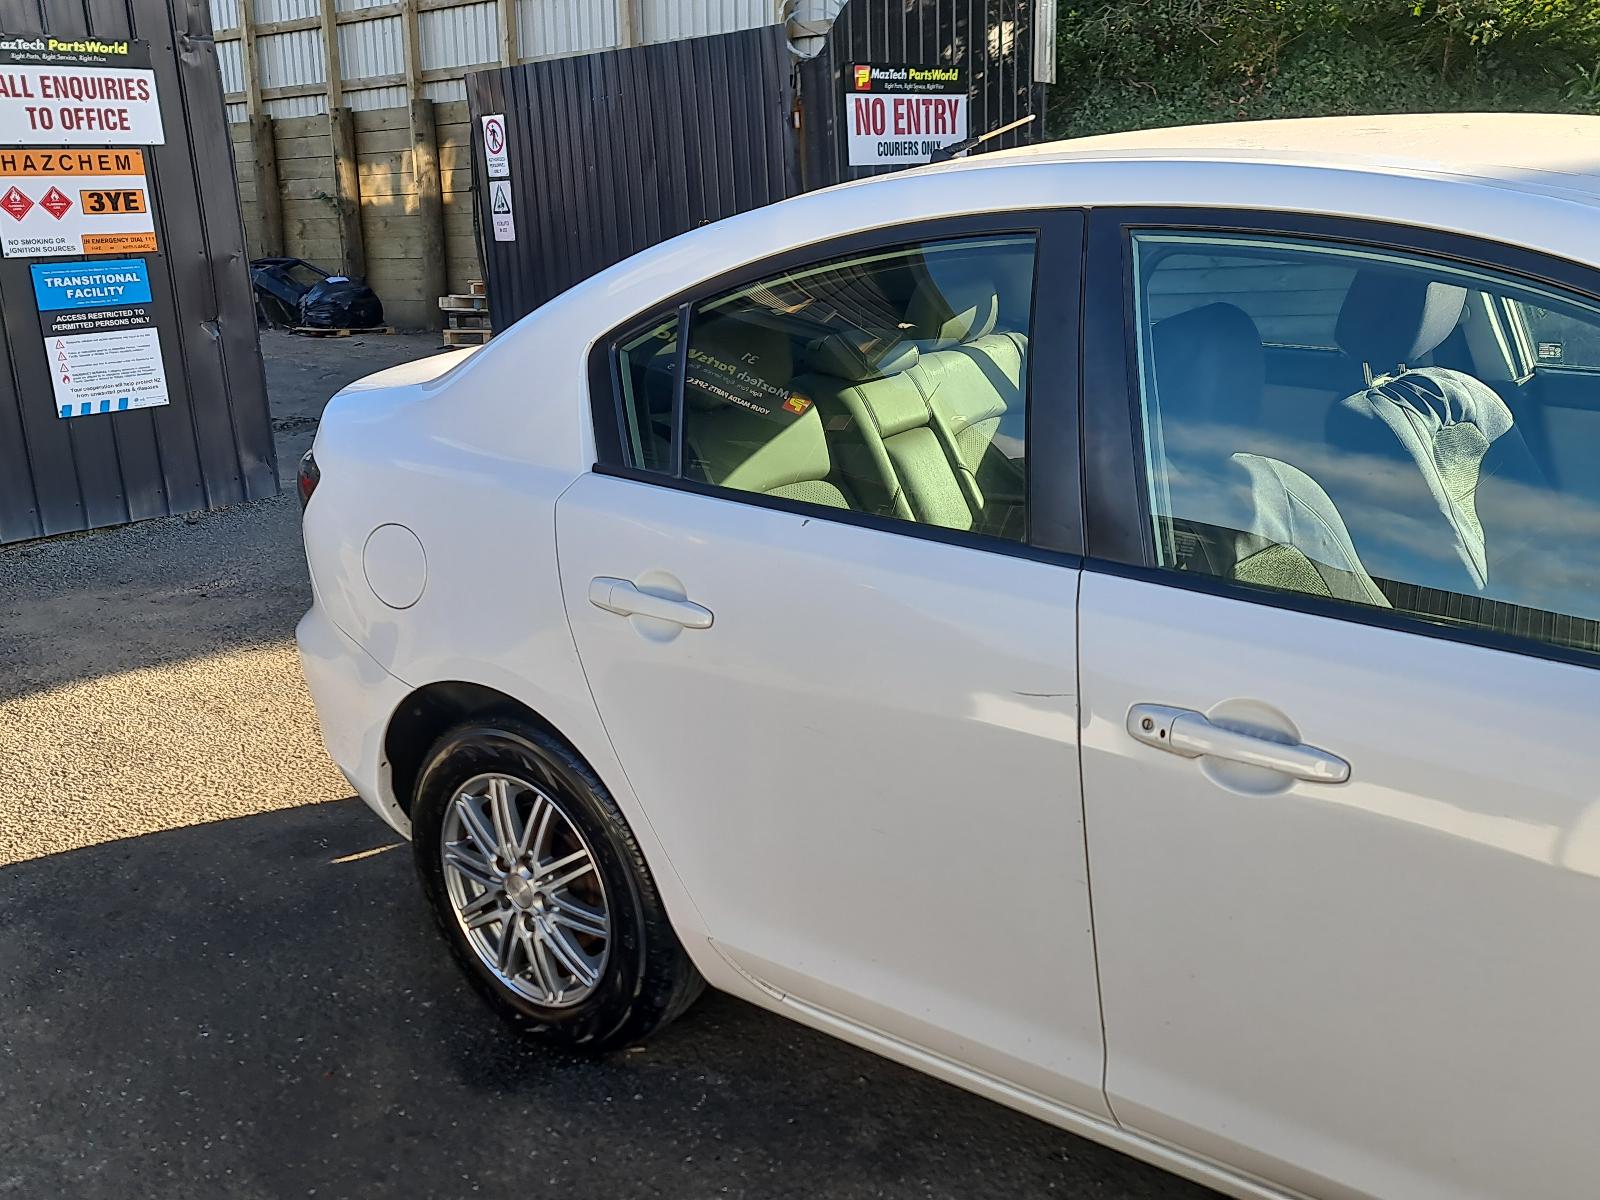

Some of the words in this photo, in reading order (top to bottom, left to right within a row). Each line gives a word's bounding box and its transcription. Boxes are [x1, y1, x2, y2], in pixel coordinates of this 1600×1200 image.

[0, 39, 44, 50] azTech
[48, 39, 128, 54] PartsWorld
[871, 68, 907, 80] MazTech
[908, 68, 959, 80] PartsWorld
[0, 74, 34, 98] ALL
[39, 76, 150, 101] ENQUIRIES
[25, 107, 53, 130] TO
[60, 107, 131, 131] OFFICE
[854, 97, 886, 135] NO
[893, 98, 959, 135] ENTRY
[877, 141, 919, 157] COURIERS
[0, 154, 131, 171] HAZCHEM
[88, 192, 139, 212] 3YE
[42, 245, 76, 253] SOURCES
[44, 273, 141, 288] TRANSITIONAL
[66, 286, 125, 299] FACILITY
[56, 313, 87, 323] ACCESS
[87, 309, 133, 320] RESTRICTED
[134, 308, 145, 316] TO
[52, 321, 94, 331] PERMITTED
[95, 318, 129, 328] PERSONS
[130, 316, 150, 325] ONLY
